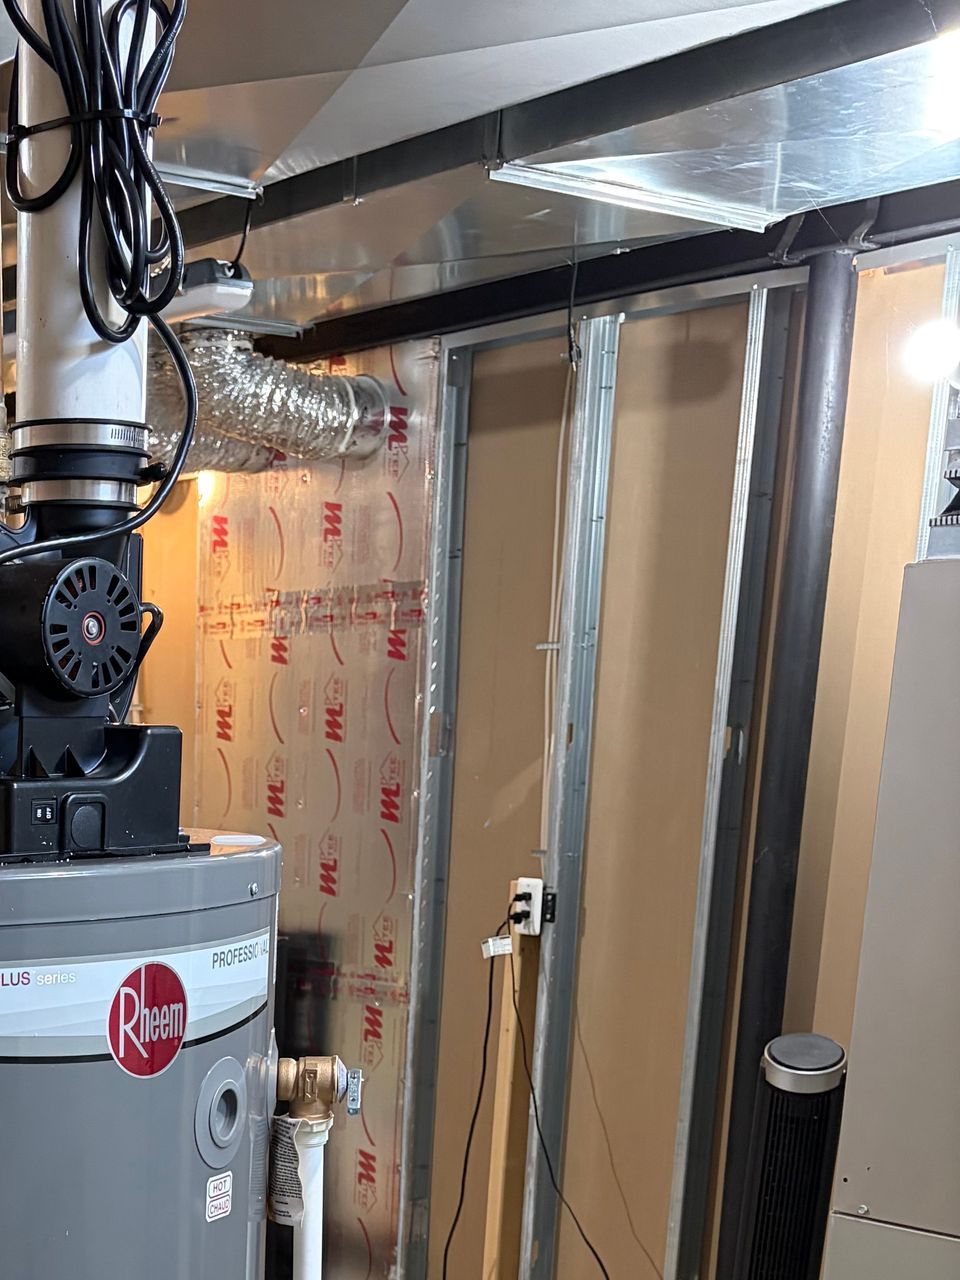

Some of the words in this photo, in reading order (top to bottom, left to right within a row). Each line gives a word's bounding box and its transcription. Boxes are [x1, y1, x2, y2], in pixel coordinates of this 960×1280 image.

[36, 971, 76, 985] series
[118, 965, 184, 1058] Rheem
[212, 1180, 227, 1193] HOT
